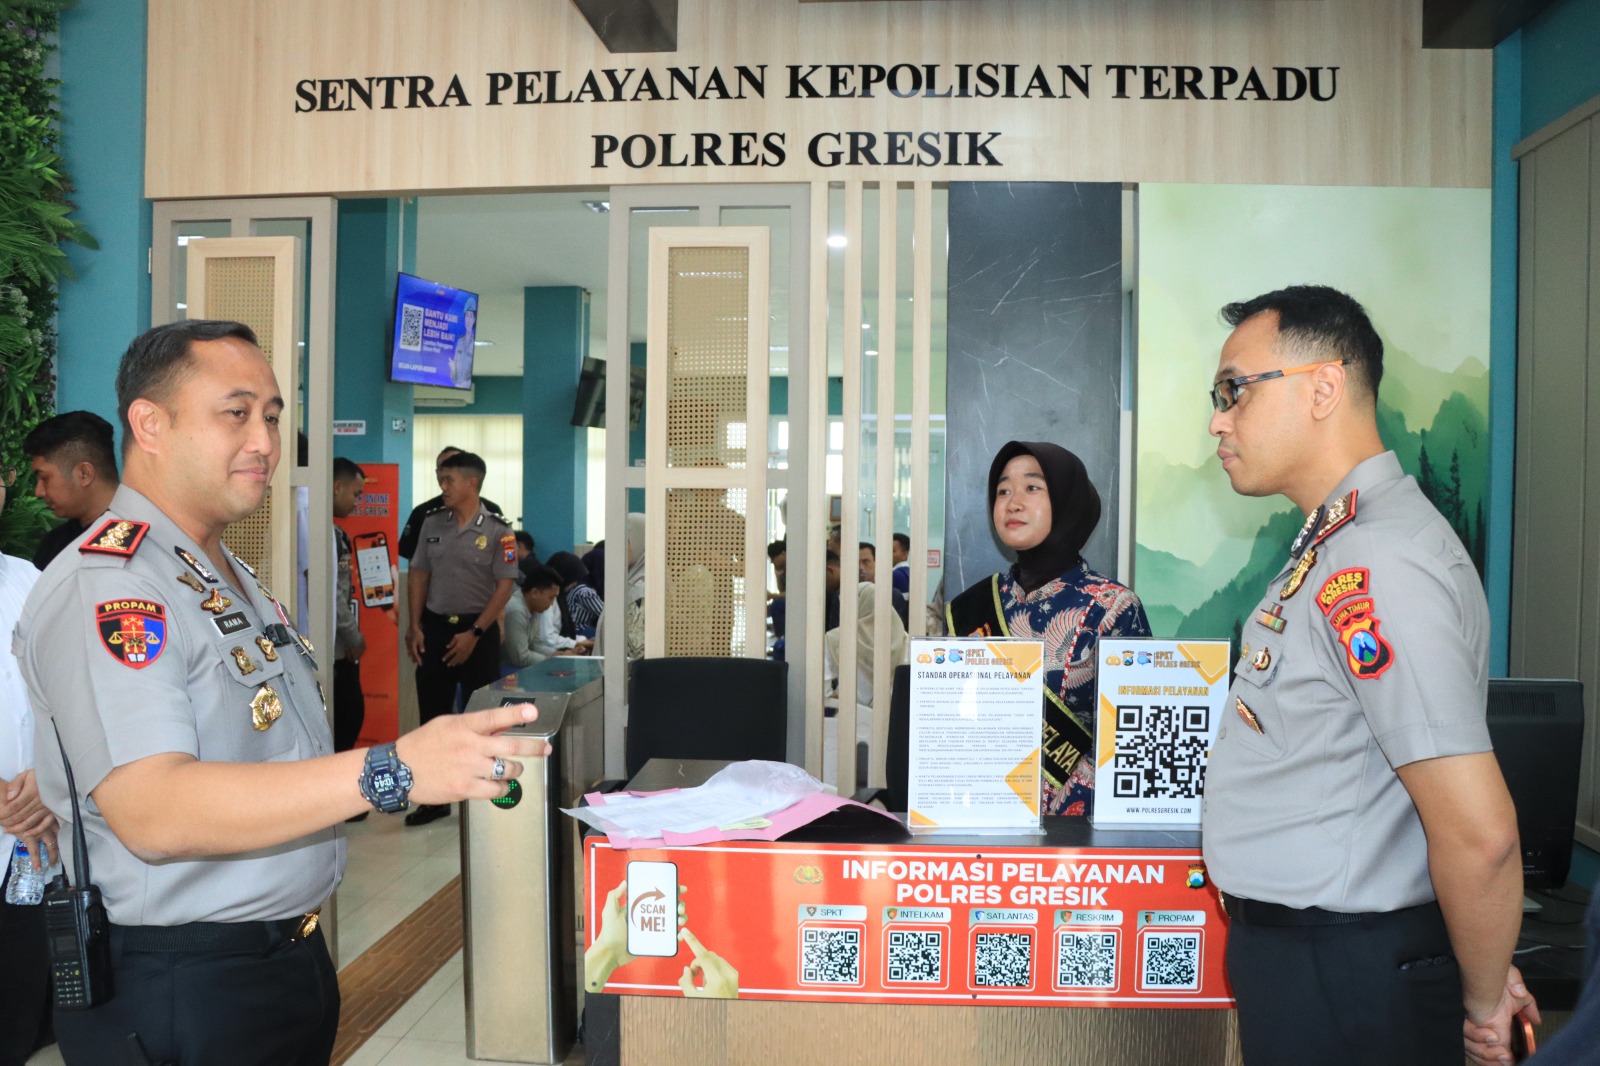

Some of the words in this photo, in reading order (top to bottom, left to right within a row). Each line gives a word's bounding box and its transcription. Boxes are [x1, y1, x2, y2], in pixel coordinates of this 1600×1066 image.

[295, 75, 470, 114] SENTRA
[487, 65, 769, 107] PELAYANAN
[787, 63, 1093, 100] KEPOLISIAN
[1105, 65, 1342, 103] TERPADU
[594, 133, 787, 170] POLRES
[807, 132, 1002, 169] GRESIK
[365, 494, 389, 504] ONLINE
[365, 506, 389, 516] GRESIK
[1320, 572, 1363, 604] POLRES
[104, 601, 156, 612] PROPAM
[1333, 609, 1349, 627] JAWA
[1347, 601, 1370, 614] TIMUR
[223, 617, 243, 629] RAMA
[967, 649, 985, 658] SPKT
[1155, 651, 1174, 660] SPKT
[1155, 660, 1178, 668] POLRES
[918, 671, 947, 679] STANDAR
[994, 672, 1031, 680] PELAYANAN
[1118, 685, 1161, 695] INFORMASI
[1163, 686, 1209, 696] PELAYANAN
[843, 860, 994, 882] INFORMASI
[1002, 862, 1165, 884] PELAYANAN
[897, 883, 1002, 905] POLRES
[1010, 885, 1108, 906] GRESIK
[640, 904, 665, 914] SCAN
[821, 908, 843, 917] SPKT
[900, 910, 944, 919] INTELKAM
[986, 912, 1034, 921] SATLANTAS
[1076, 914, 1114, 922] RESKRIM
[1158, 914, 1195, 922] PROPAM
[641, 916, 665, 932] ME!
